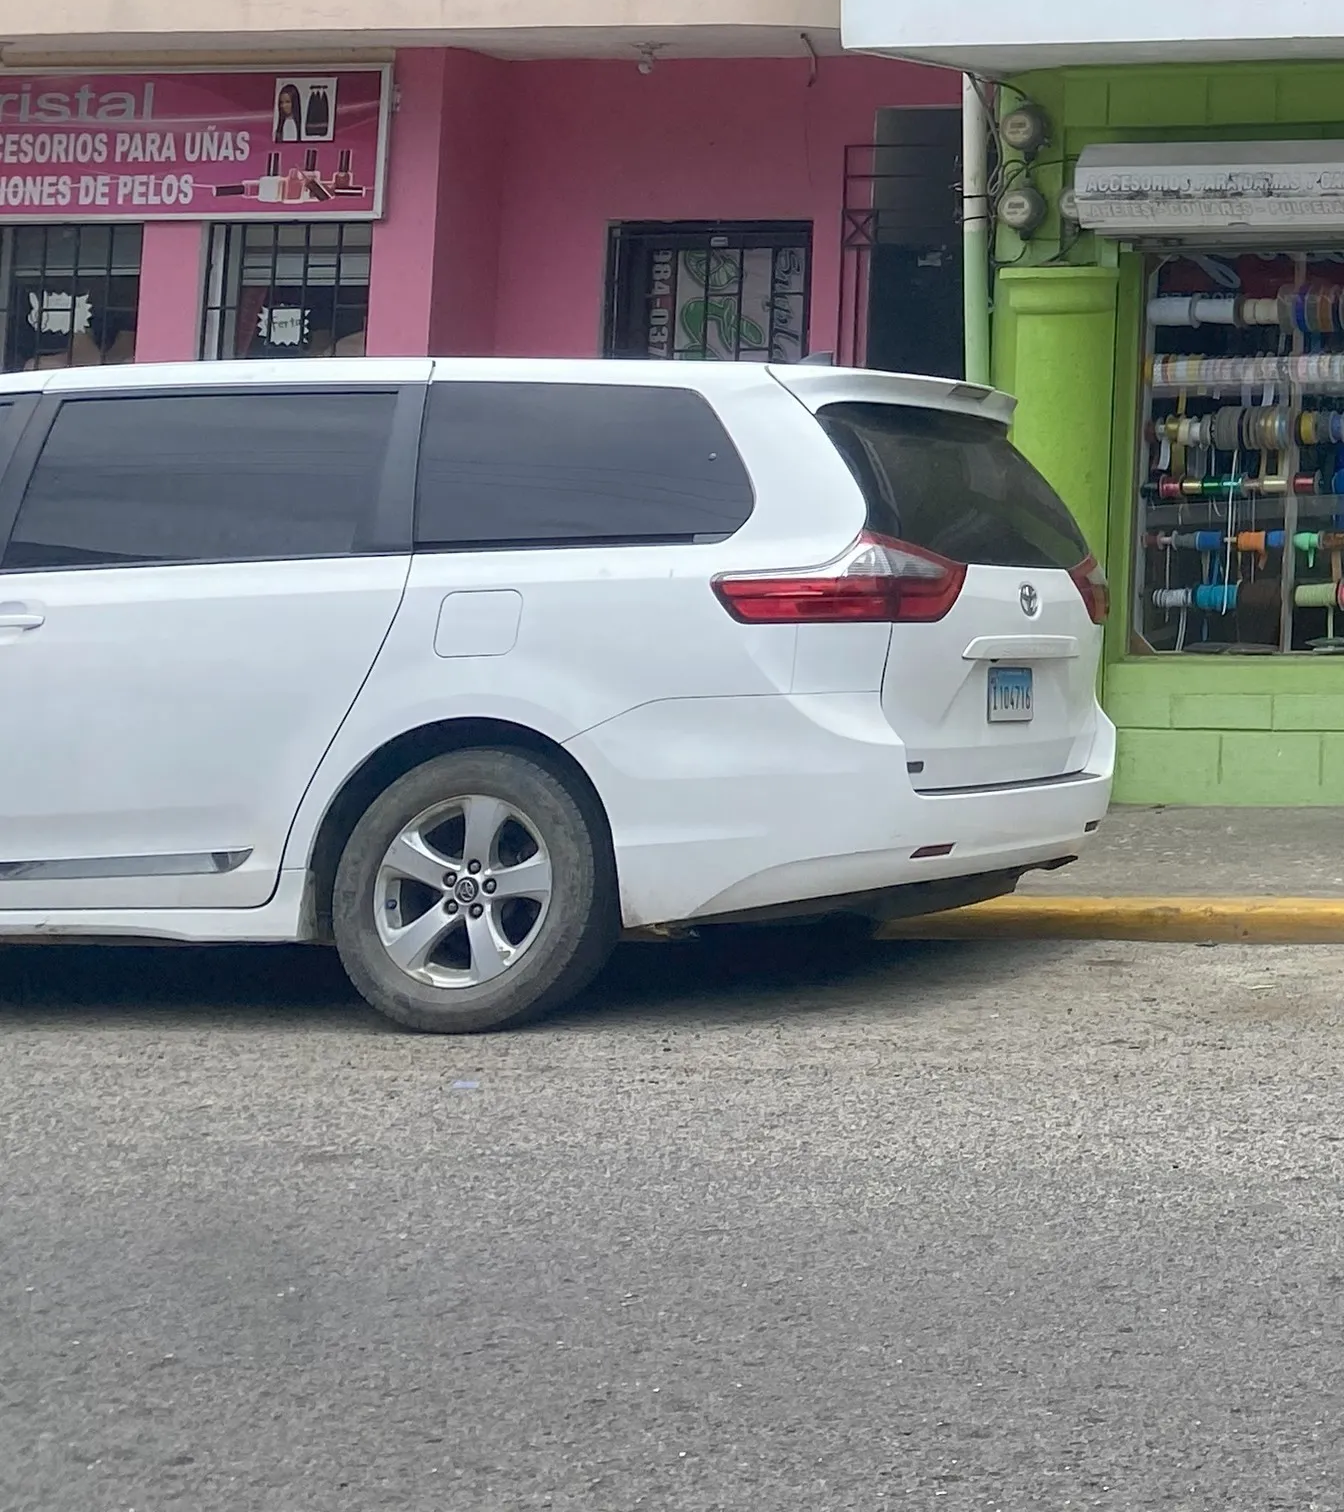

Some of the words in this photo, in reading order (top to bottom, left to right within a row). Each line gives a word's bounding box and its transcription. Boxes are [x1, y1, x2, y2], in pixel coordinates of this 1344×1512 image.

[115, 132, 179, 162] PARA
[185, 125, 251, 161] UÑAS
[79, 176, 111, 206] DE
[117, 174, 194, 205] PELOS
